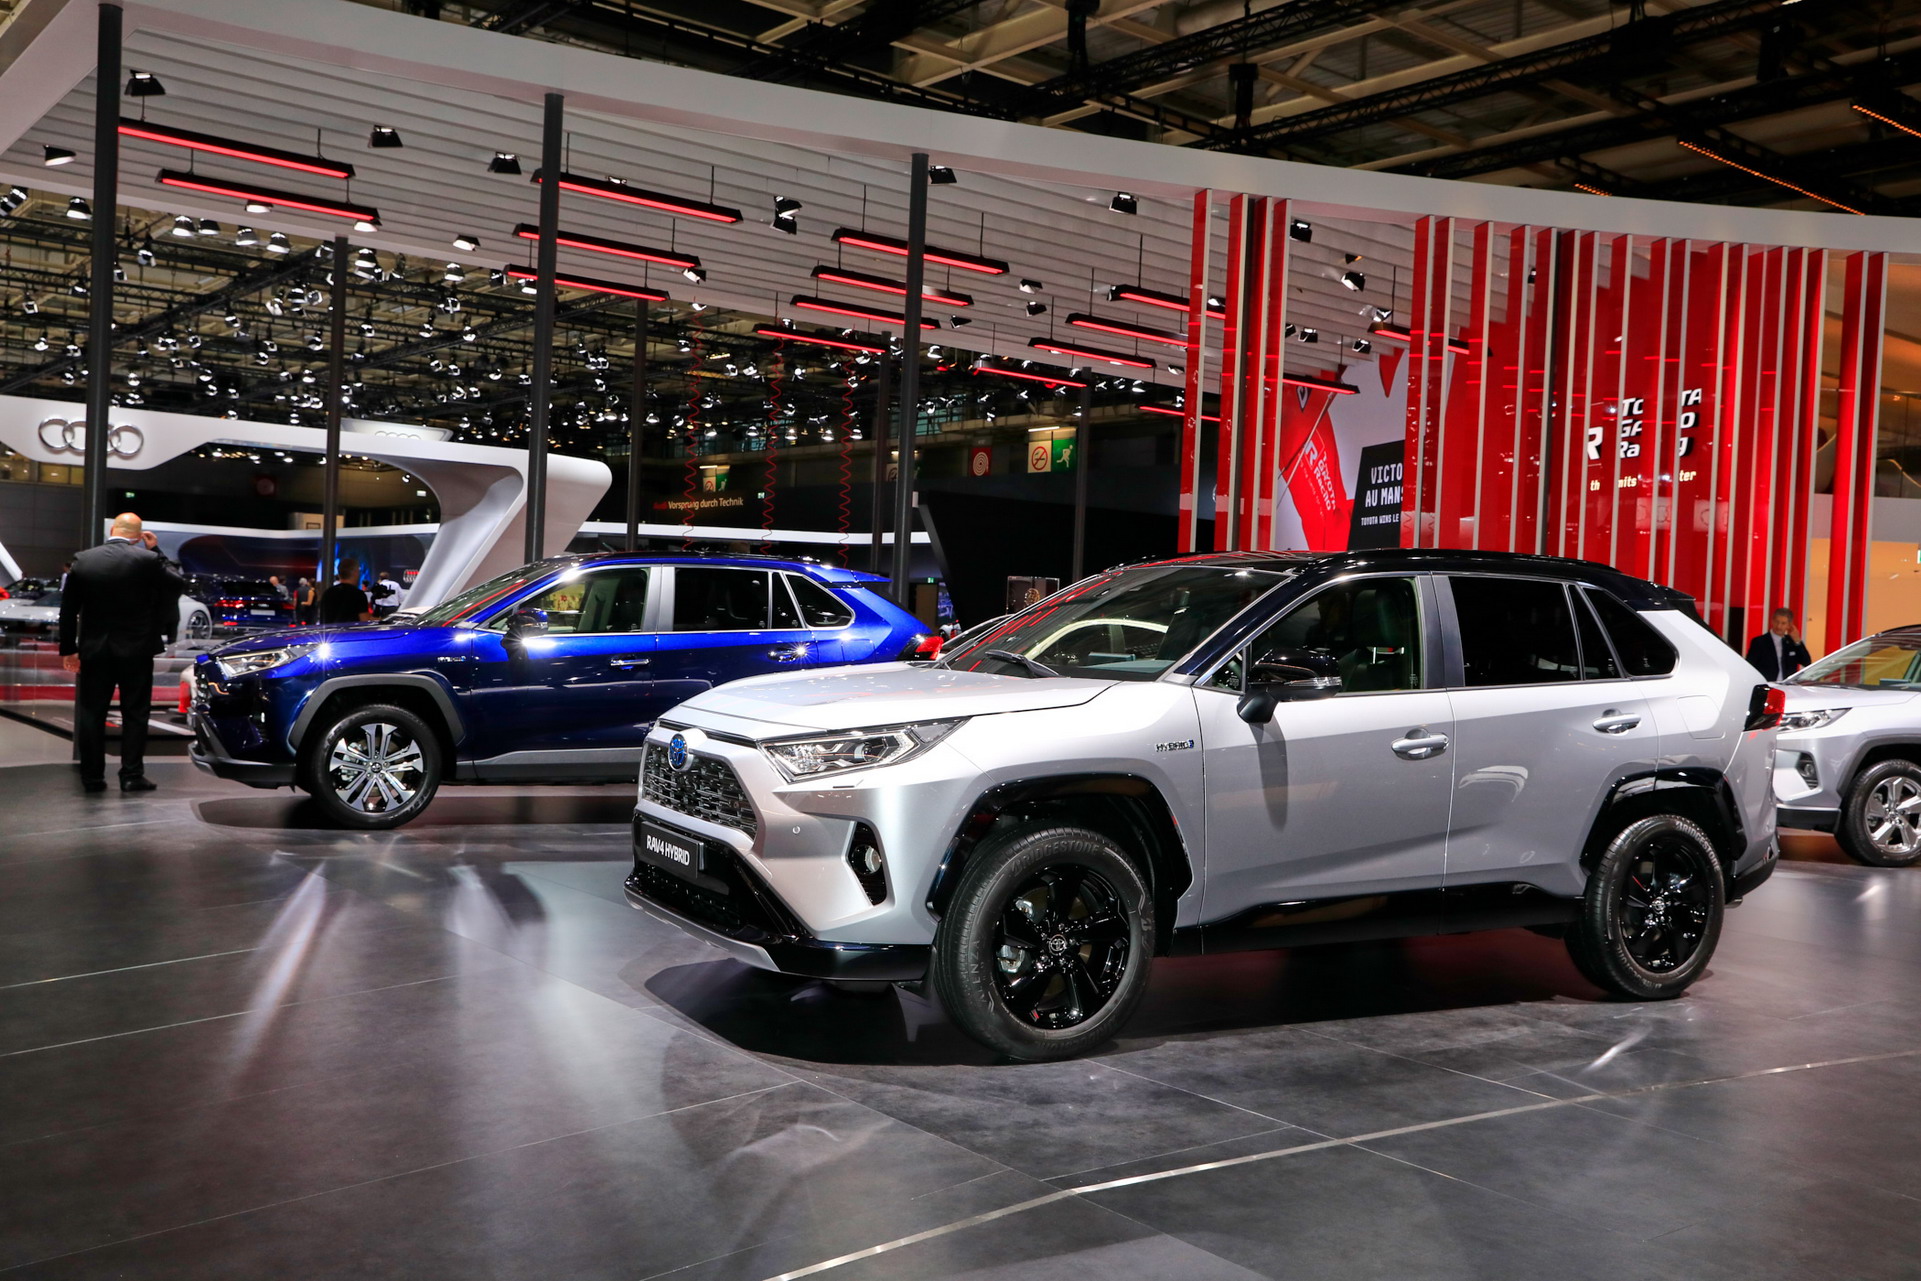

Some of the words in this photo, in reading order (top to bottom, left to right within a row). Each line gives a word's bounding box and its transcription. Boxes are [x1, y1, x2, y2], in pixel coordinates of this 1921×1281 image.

[668, 500, 700, 510] Vorsprung
[700, 499, 718, 508] durch
[718, 497, 743, 507] Technik
[1365, 489, 1378, 507] AU
[1393, 513, 1399, 522] LE
[646, 834, 665, 855] RAV4
[665, 842, 690, 866] HYBRID
